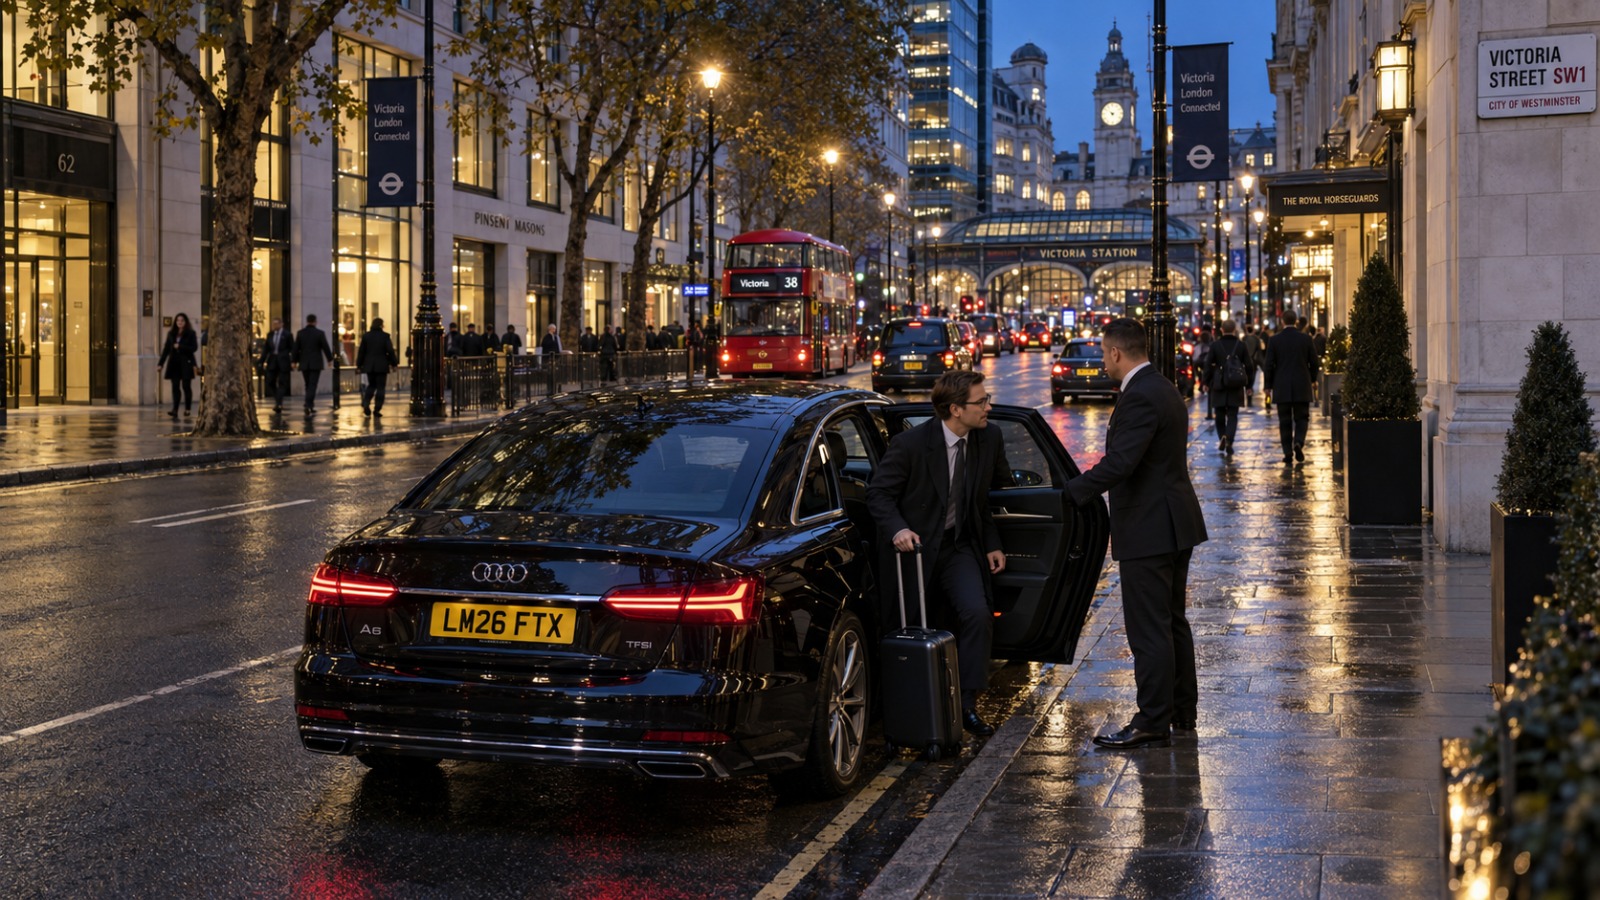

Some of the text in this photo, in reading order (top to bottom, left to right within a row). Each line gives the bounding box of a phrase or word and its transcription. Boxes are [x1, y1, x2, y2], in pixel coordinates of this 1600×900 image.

[1489, 46, 1561, 66] VICTORIA
[1180, 72, 1215, 83] Victoria
[1489, 66, 1586, 88] STREET SW1
[1181, 87, 1213, 98] London
[374, 103, 405, 113] Victoria
[1180, 101, 1221, 112] Connected
[1489, 96, 1581, 110] CITY OF WESTMINSTER
[374, 117, 403, 127] London
[374, 131, 410, 141] Connected
[58, 153, 75, 173] 62
[1283, 194, 1379, 205] THE ROYAL HORSEGUARDS
[514, 219, 545, 236] MASONS
[1040, 248, 1137, 258] VICTORIA STATION
[740, 276, 798, 288] Victoria 38
[443, 608, 563, 638] LM26 FTX
[360, 623, 382, 636] A6
[625, 640, 652, 649] TFSI
